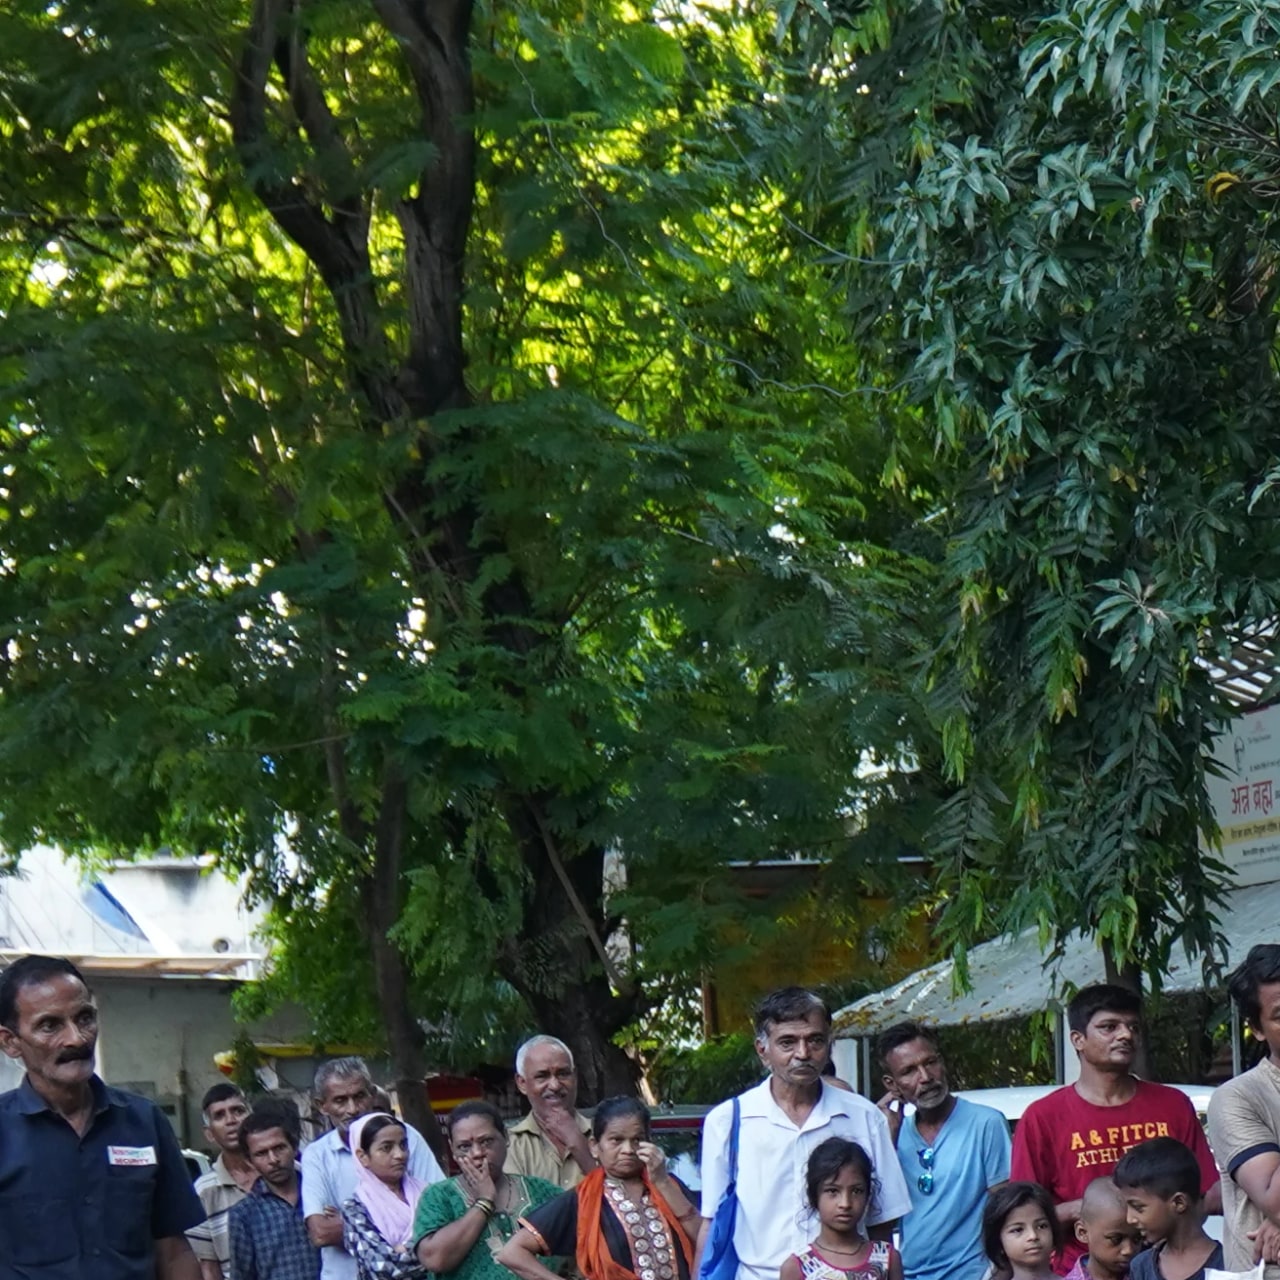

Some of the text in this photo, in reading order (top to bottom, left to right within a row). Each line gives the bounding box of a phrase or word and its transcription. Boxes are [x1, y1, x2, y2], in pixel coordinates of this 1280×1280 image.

[1070, 1121, 1170, 1151] A & FITCH
